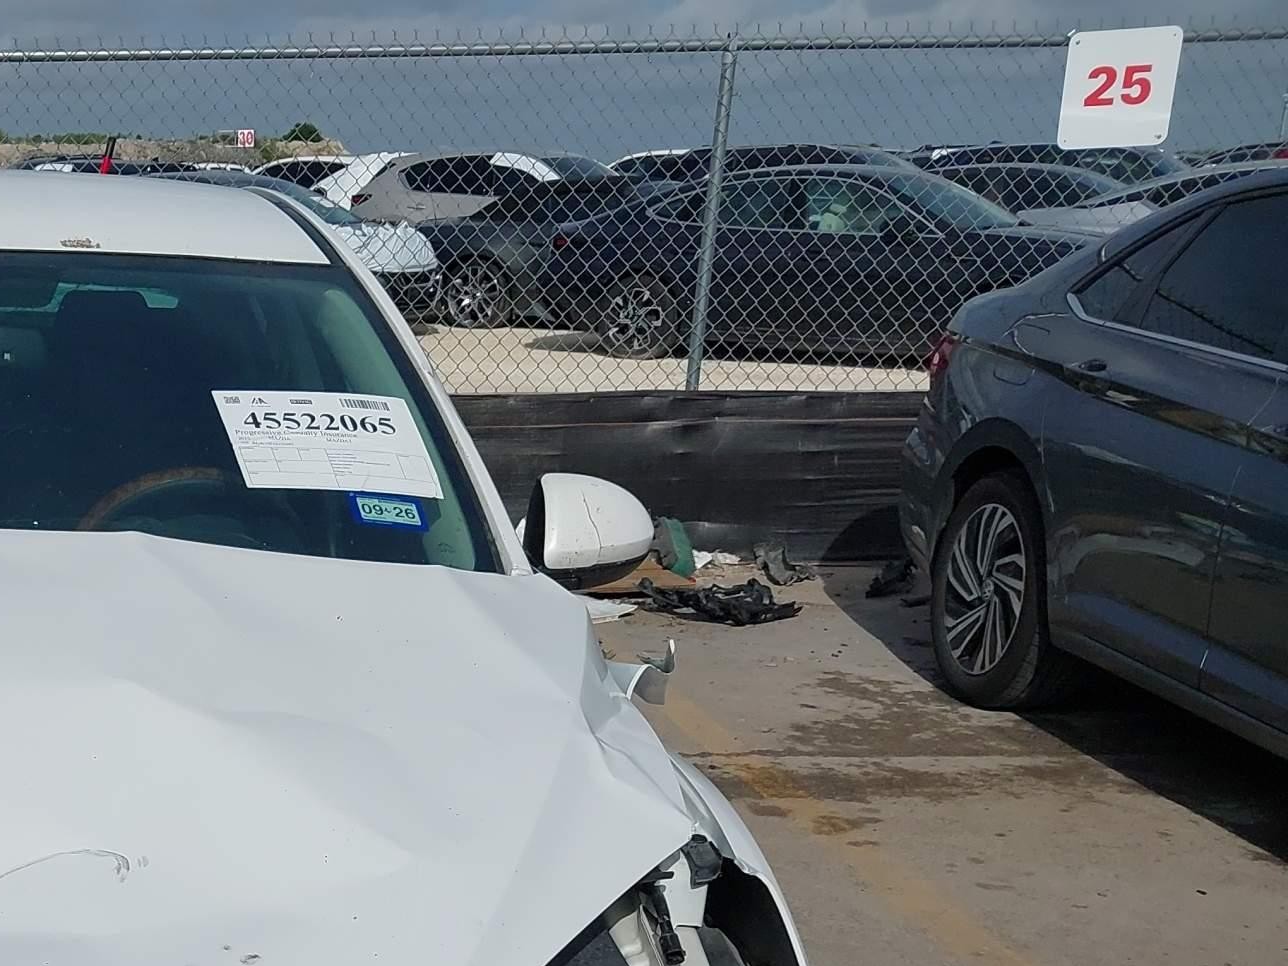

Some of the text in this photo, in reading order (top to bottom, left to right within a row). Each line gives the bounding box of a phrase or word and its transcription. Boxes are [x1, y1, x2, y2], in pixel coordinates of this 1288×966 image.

[1083, 64, 1153, 107] 25
[239, 131, 253, 145] 30
[243, 411, 396, 435] 45522065
[361, 503, 416, 519] 09 26
